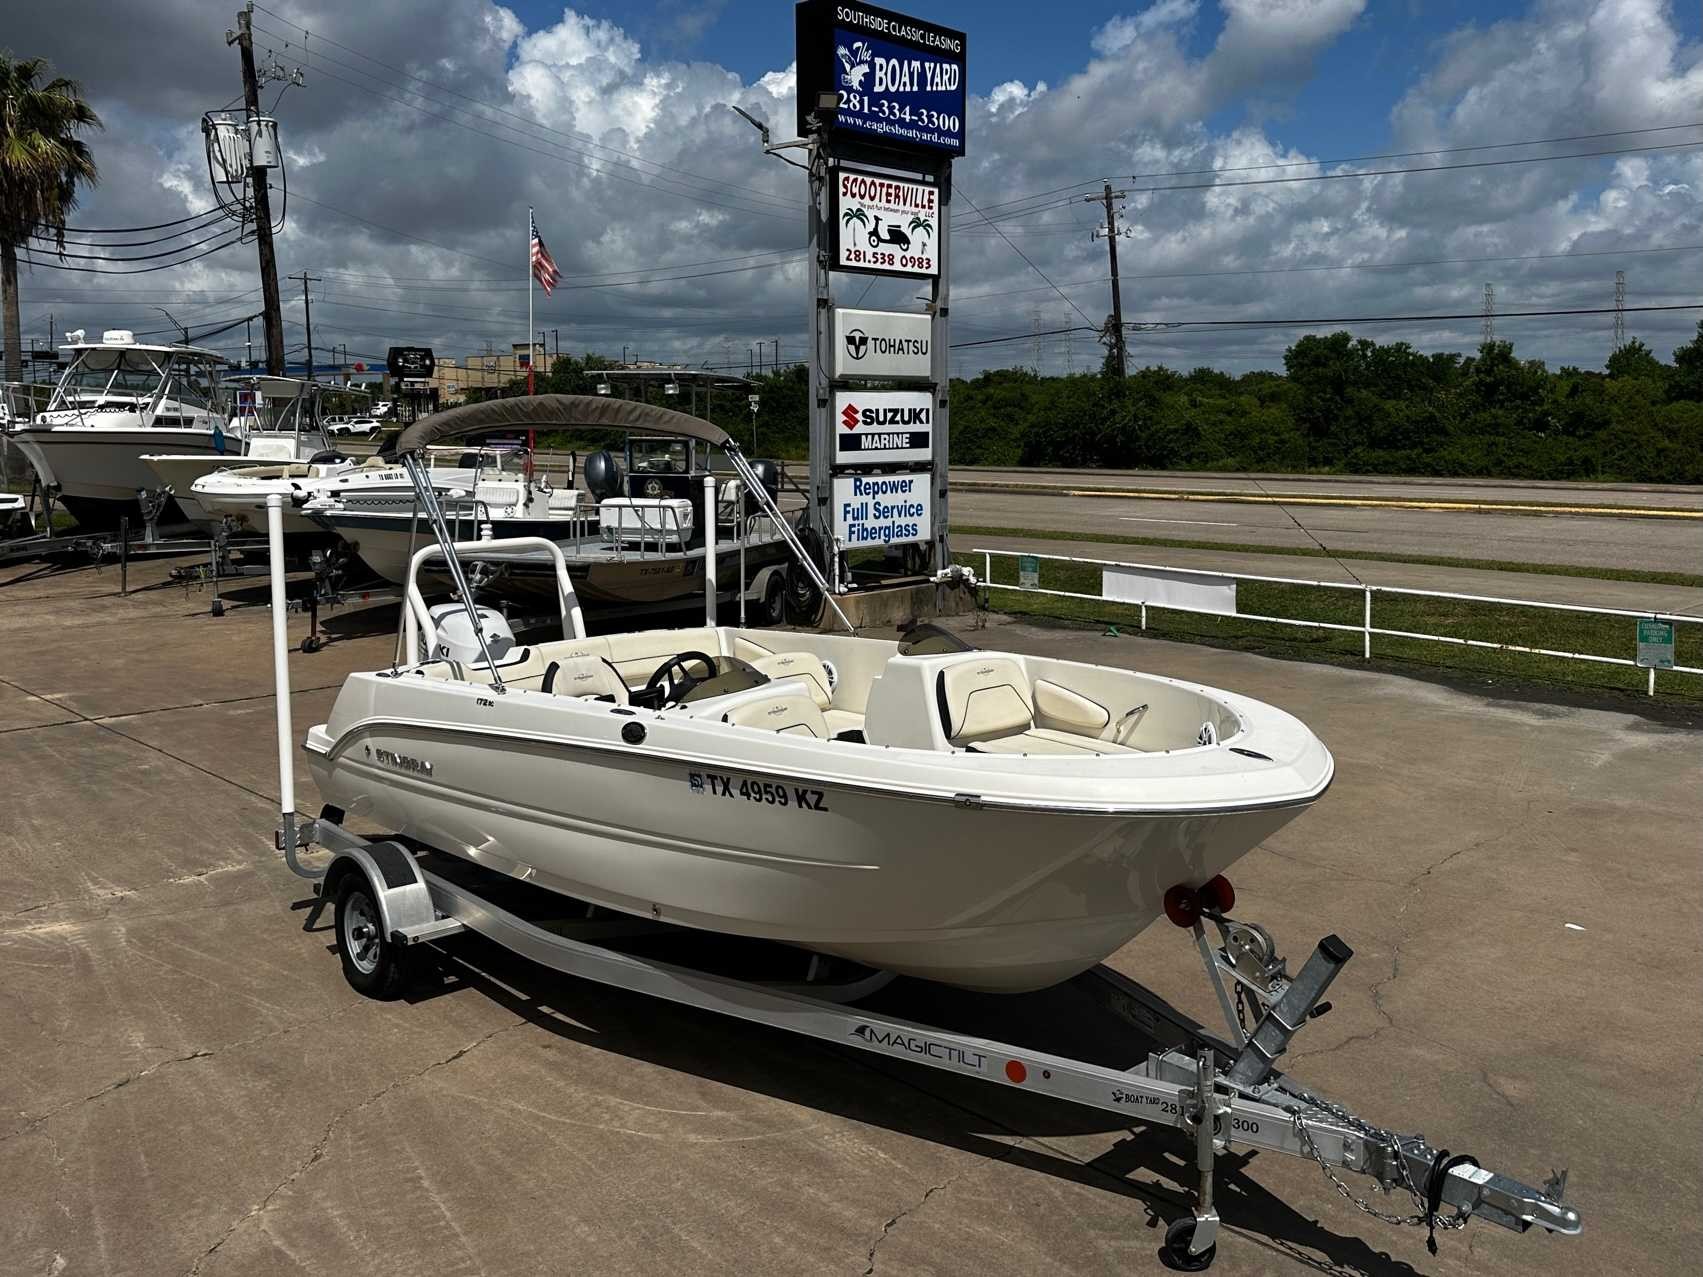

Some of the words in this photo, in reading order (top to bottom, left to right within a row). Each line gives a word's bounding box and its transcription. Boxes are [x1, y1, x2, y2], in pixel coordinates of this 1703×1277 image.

[836, 6, 889, 33] SOUTHSIDE
[890, 22, 924, 43] CLASSIC
[925, 32, 961, 53] LEASING
[852, 41, 872, 63] The
[873, 57, 921, 92] BOAT
[925, 61, 959, 92] YARD
[838, 90, 959, 133] 281-334-3300
[838, 113, 959, 146] www.eaglesboatyard.com
[842, 175, 935, 210] SCOOTERVILLE
[924, 211, 935, 219] LLC
[900, 254, 932, 270] 0983
[871, 337, 929, 356] TOHATSU
[861, 407, 930, 426] SUZUKI
[861, 433, 910, 450] MARINE
[853, 477, 914, 500] Repower
[843, 502, 869, 522] Full
[872, 500, 924, 520] Service
[848, 520, 918, 544] Fiberglass
[706, 774, 734, 799] TX
[740, 779, 788, 807] 4959
[794, 788, 829, 812] KZ
[869, 1028, 987, 1069] MAGICTILT
[1125, 1093, 1143, 1105] BOAT
[1145, 1095, 1161, 1105] YARD
